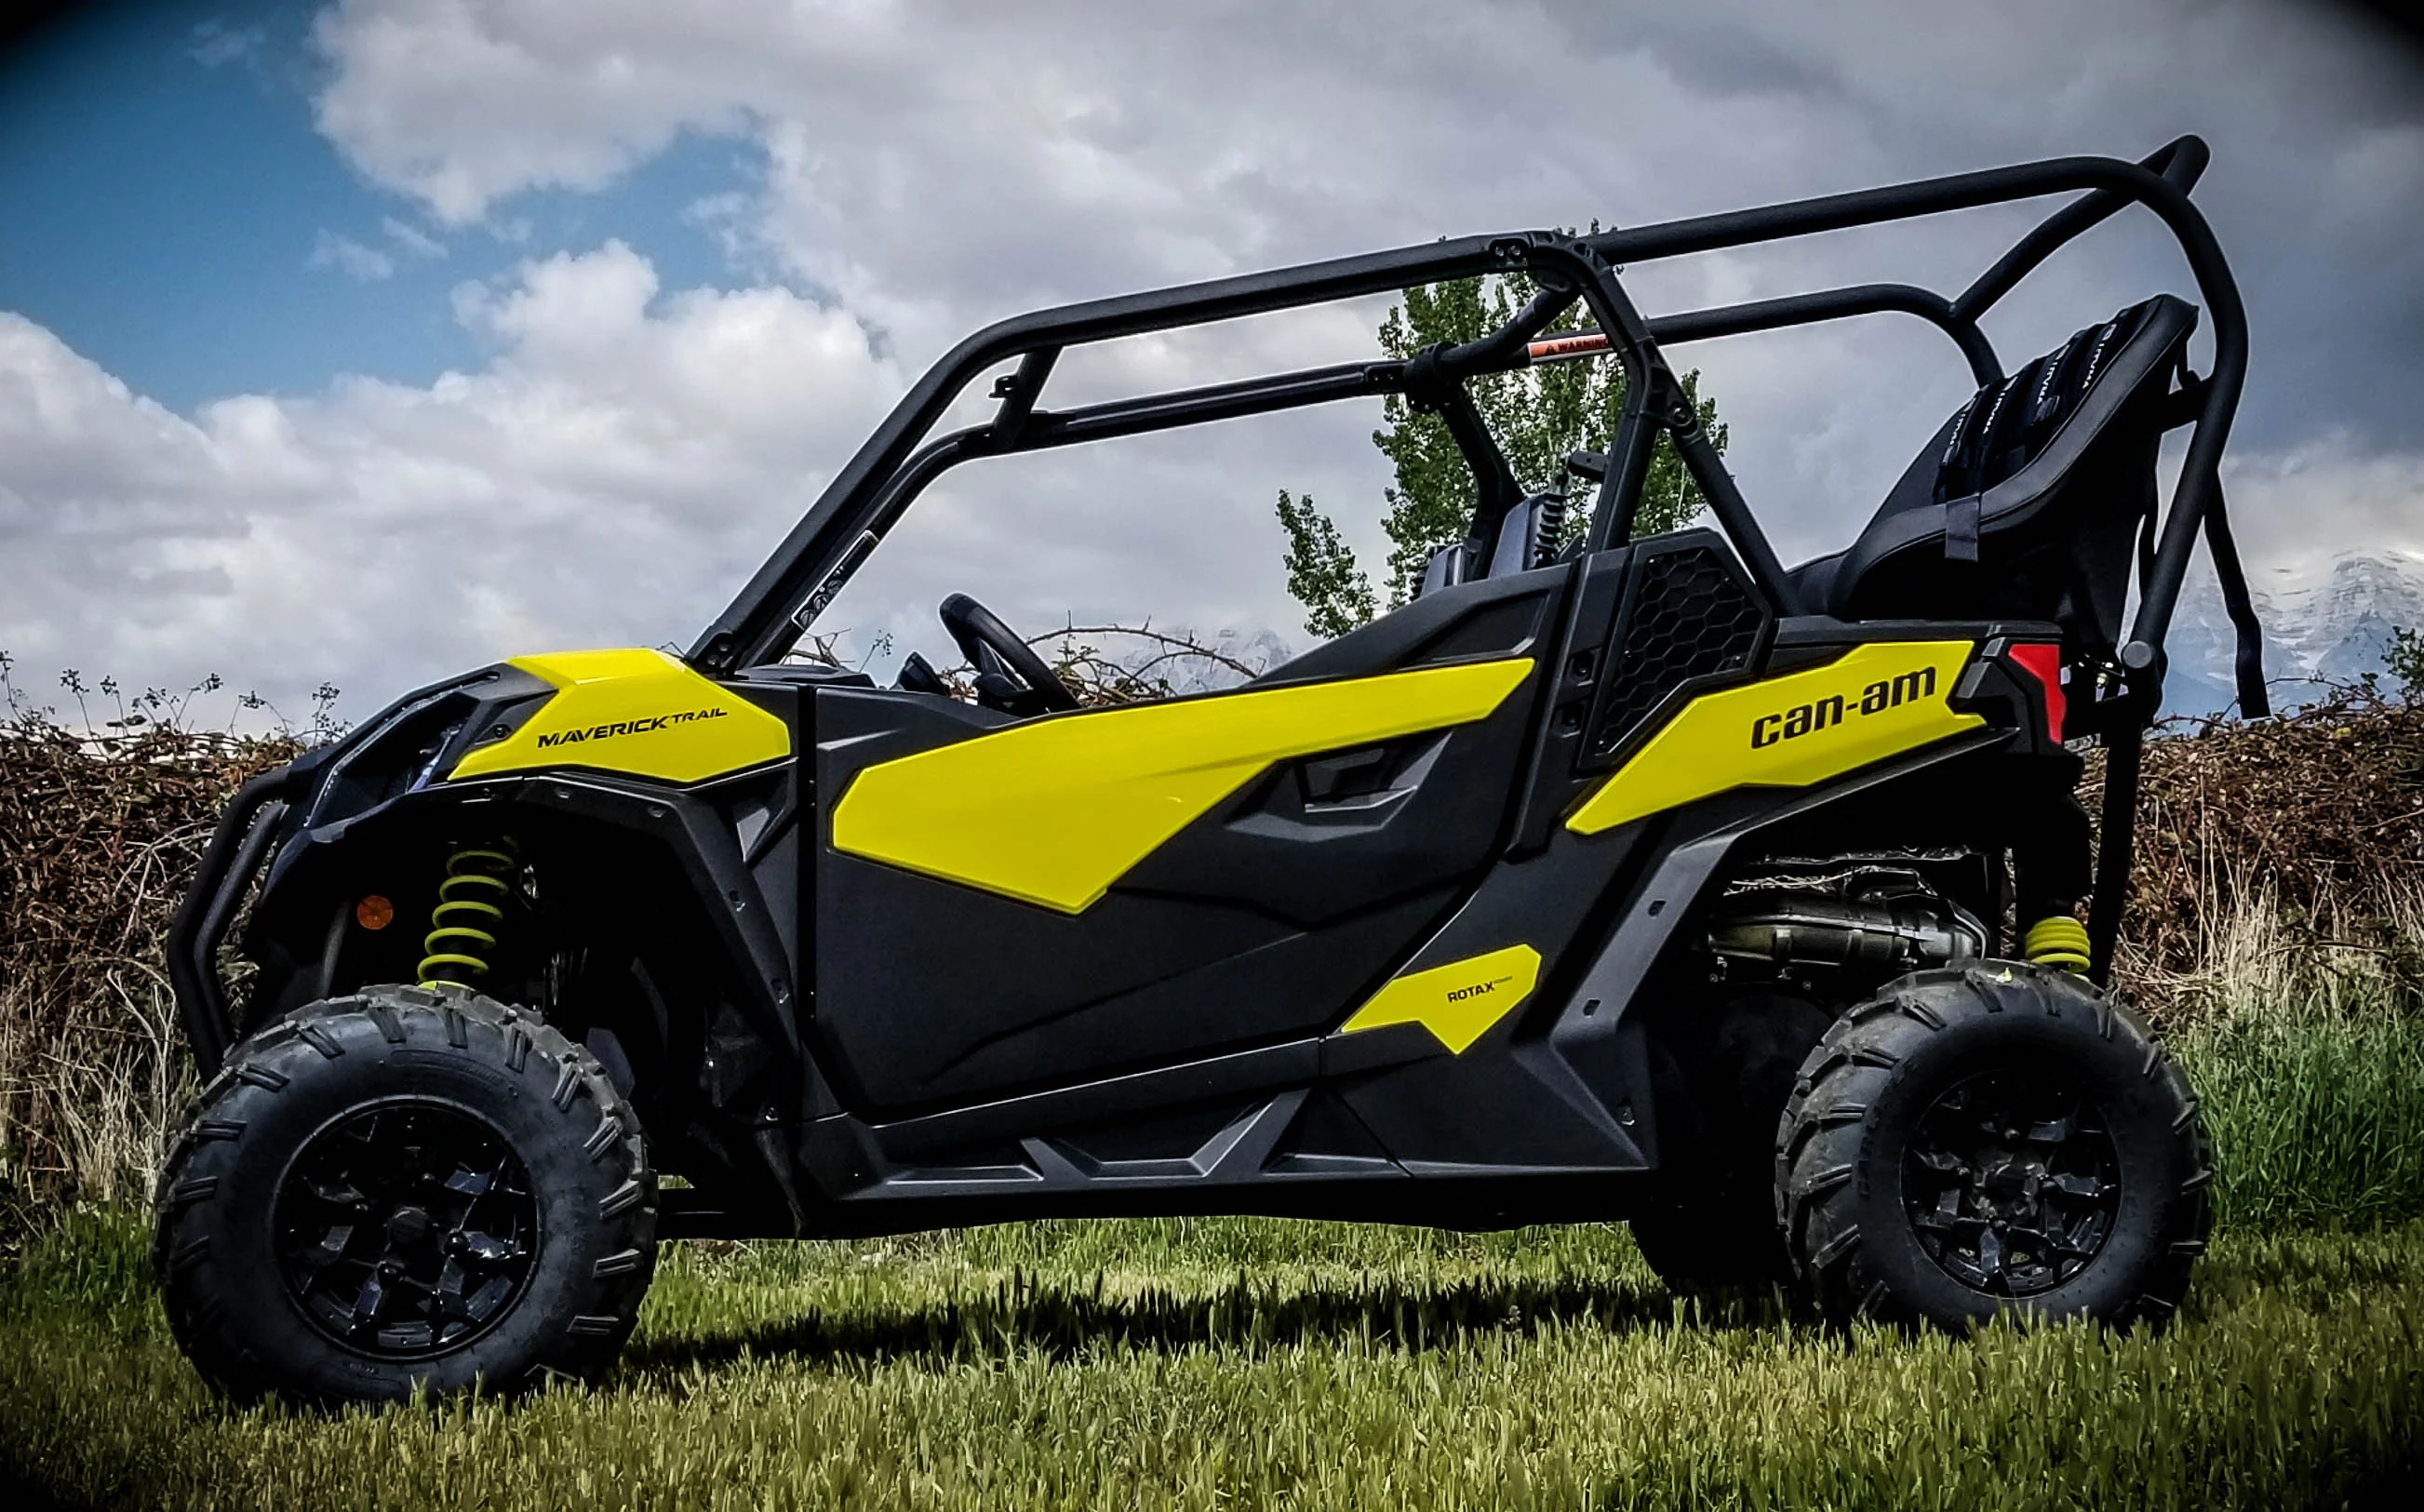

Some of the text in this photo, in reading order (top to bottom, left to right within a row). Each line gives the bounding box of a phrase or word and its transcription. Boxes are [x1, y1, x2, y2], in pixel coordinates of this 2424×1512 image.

[1558, 338, 1609, 353] WARNING
[1750, 665, 1936, 750] can-am
[537, 707, 728, 749] MAVERICK TRAIL
[1447, 981, 1495, 1003] ROTAX
